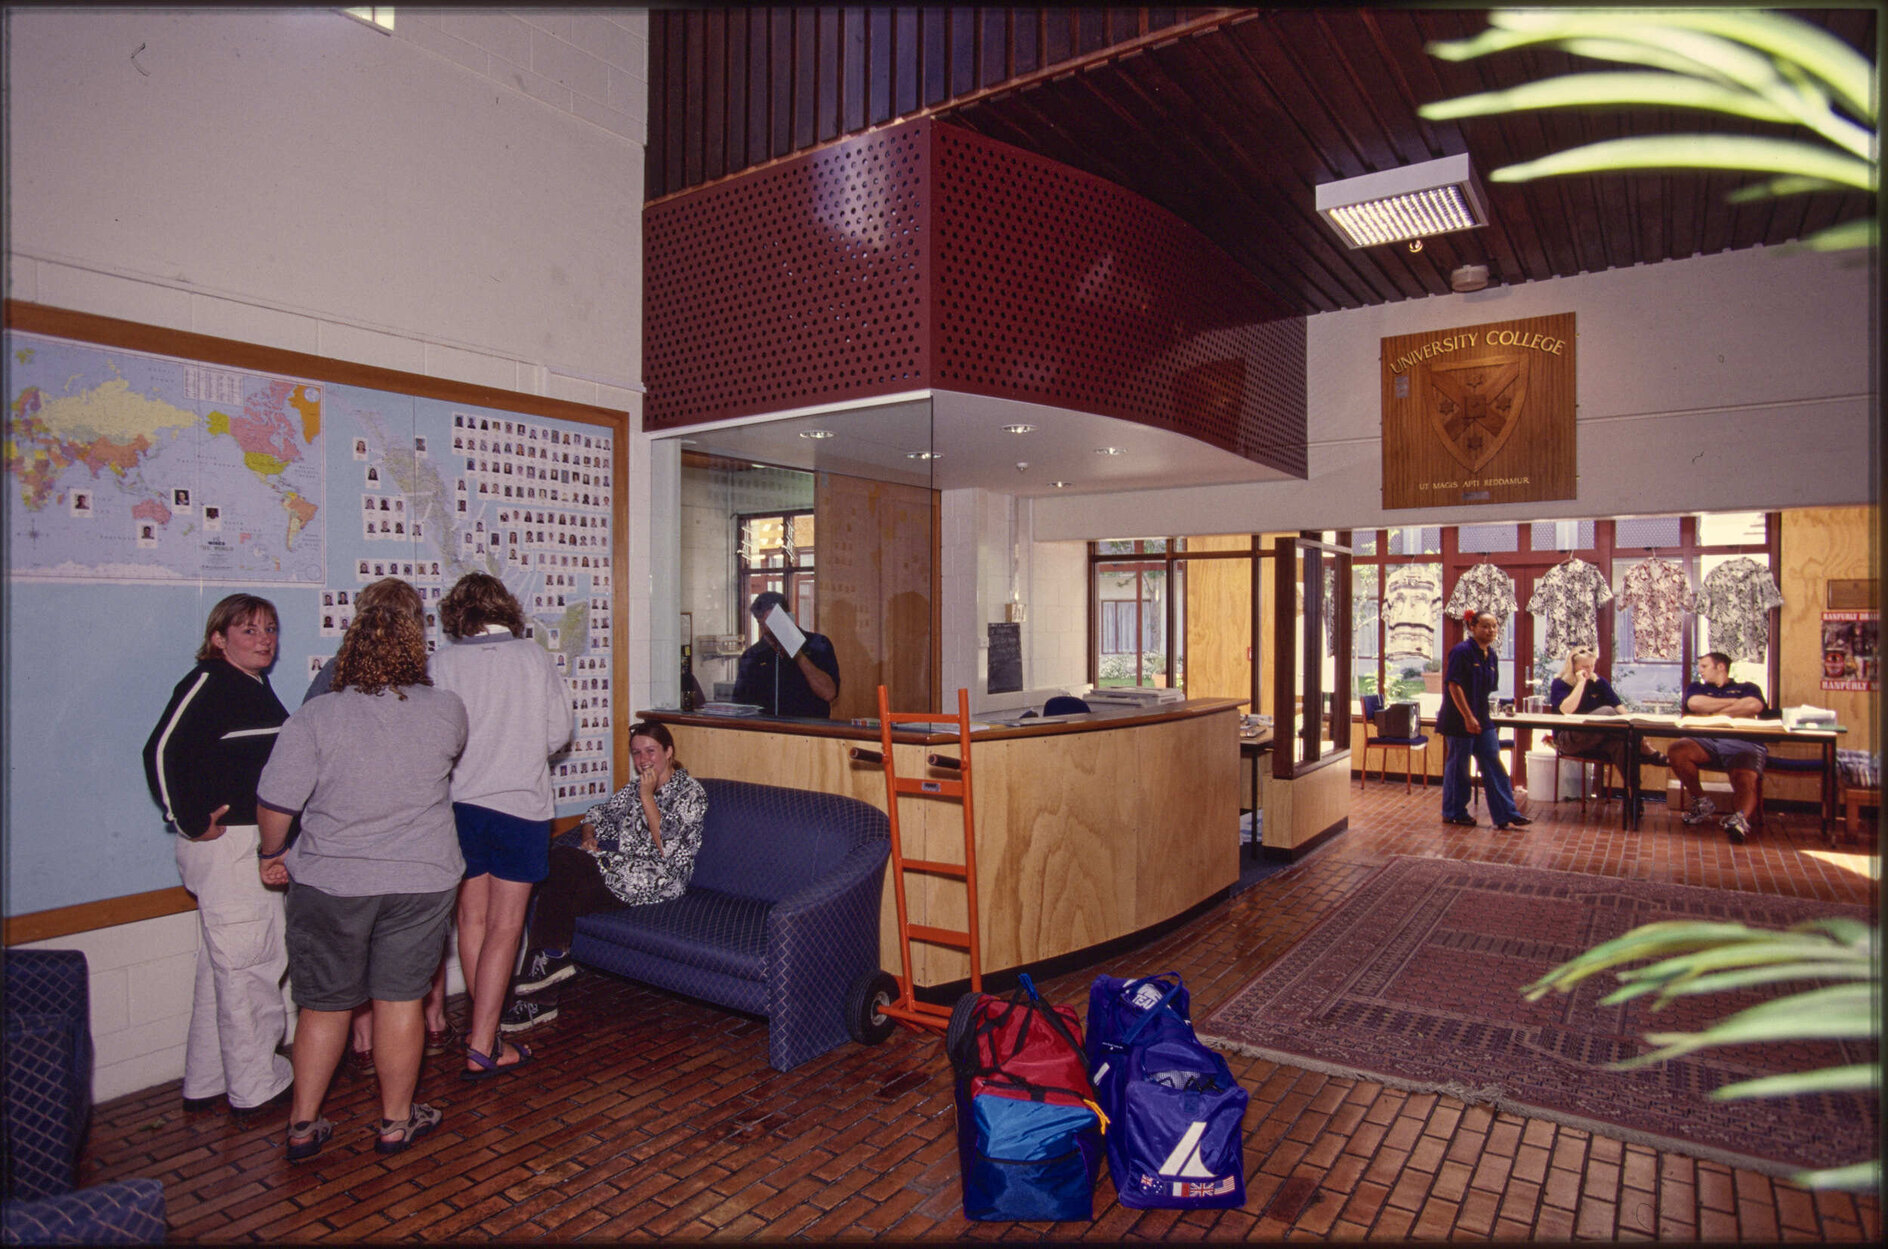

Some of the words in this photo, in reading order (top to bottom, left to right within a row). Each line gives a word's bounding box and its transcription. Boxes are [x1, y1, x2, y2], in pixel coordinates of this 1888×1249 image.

[1390, 332, 1478, 374] UNIVERSITY
[1485, 330, 1566, 355] COLLEGE
[1433, 481, 1458, 490] MAGIS
[1462, 479, 1480, 488] APTI
[1822, 680, 1867, 690] RANFURLY
